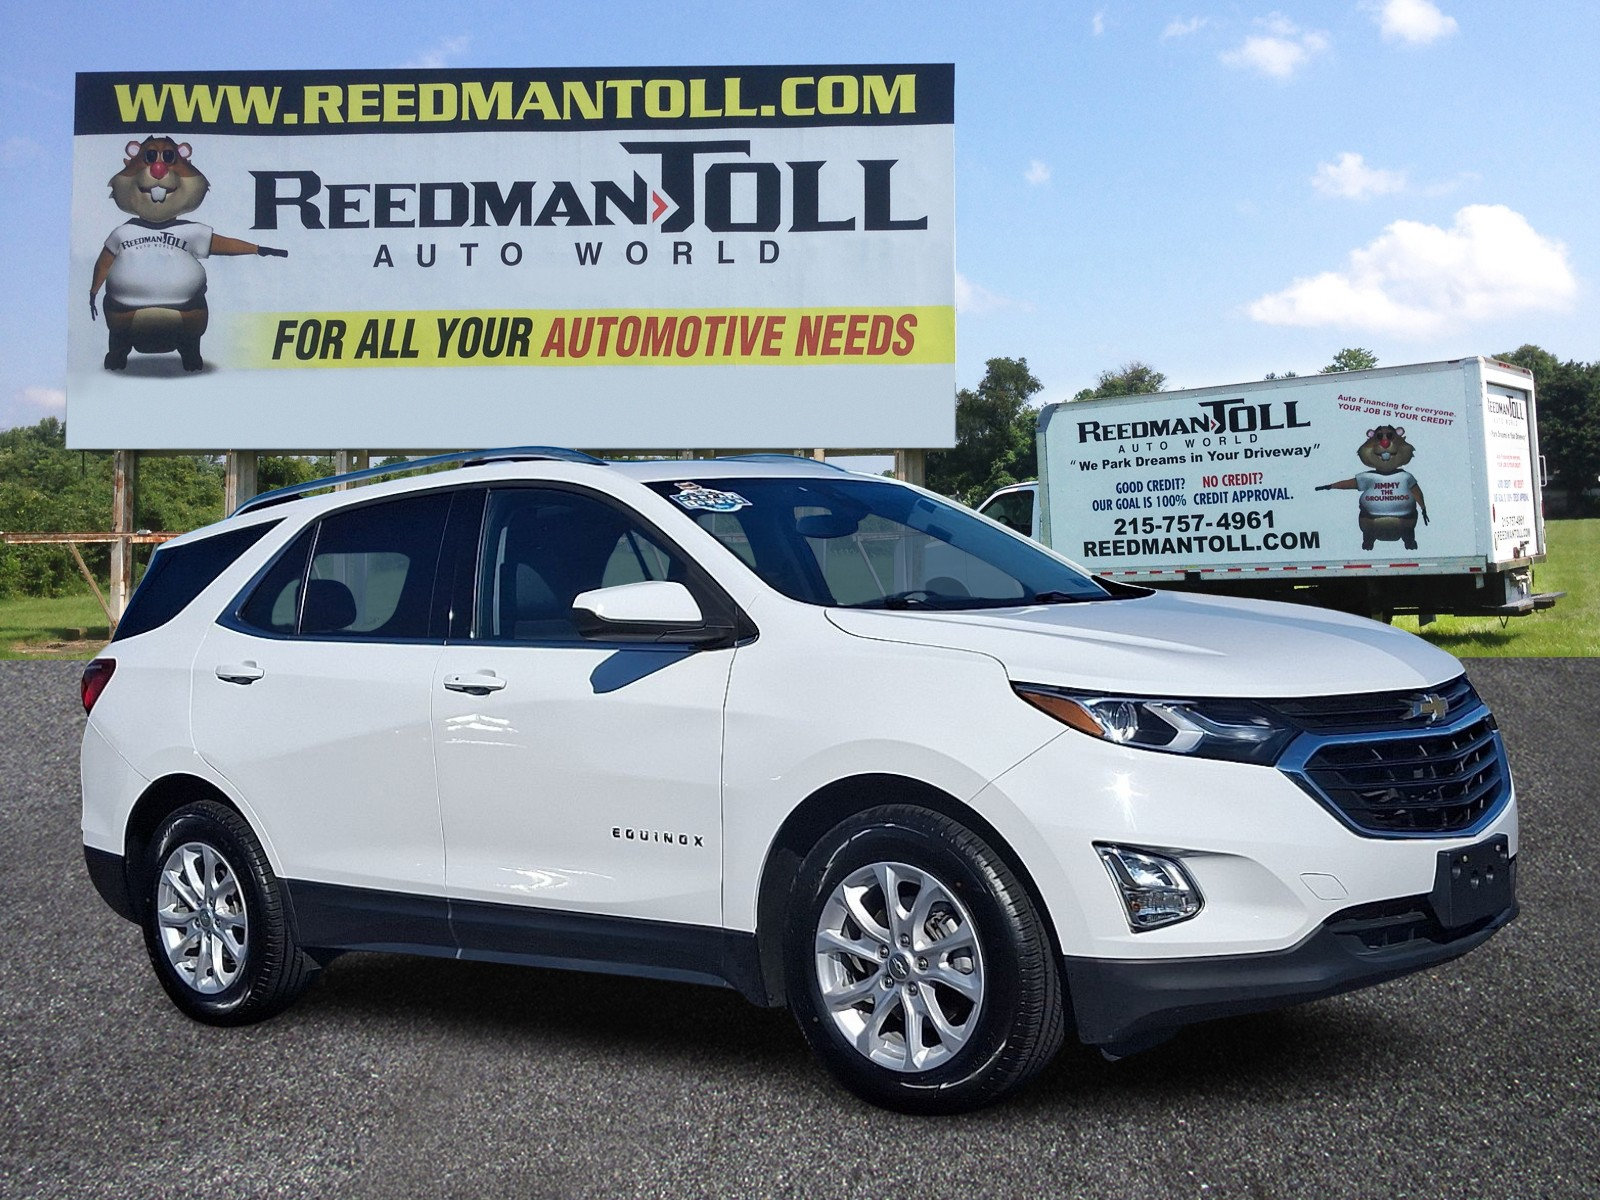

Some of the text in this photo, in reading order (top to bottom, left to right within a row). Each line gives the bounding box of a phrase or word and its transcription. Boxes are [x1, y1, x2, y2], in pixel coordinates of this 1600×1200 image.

[113, 73, 917, 125] WWW.REEDMANTOLL.COM
[373, 240, 780, 268] AUTO WORLD
[272, 313, 918, 360] FOR ALL YOUR AUTOMOTIVE NEEDS
[1337, 394, 1457, 418] Auto Financing for everyone.
[1338, 403, 1361, 412] YOUR
[1363, 407, 1380, 415] JOB
[1394, 411, 1418, 421] YOUR
[1420, 415, 1454, 426] CREDIT
[1118, 433, 1258, 454] AUTO WORLD
[1102, 458, 1132, 470] Park
[1135, 454, 1187, 467] Dreams
[1190, 452, 1203, 463] in
[1207, 449, 1241, 462] Your
[1115, 472, 1263, 494] GOOD CREDIT? NO CREDIT?
[1092, 487, 1294, 511] OUR GOAL IS 100% CREDIT APPROVAL.
[1114, 509, 1275, 536] 215-757-4961
[1083, 531, 1320, 558] REEDMANTOLL.COM
[612, 828, 703, 848] EQUINOX
